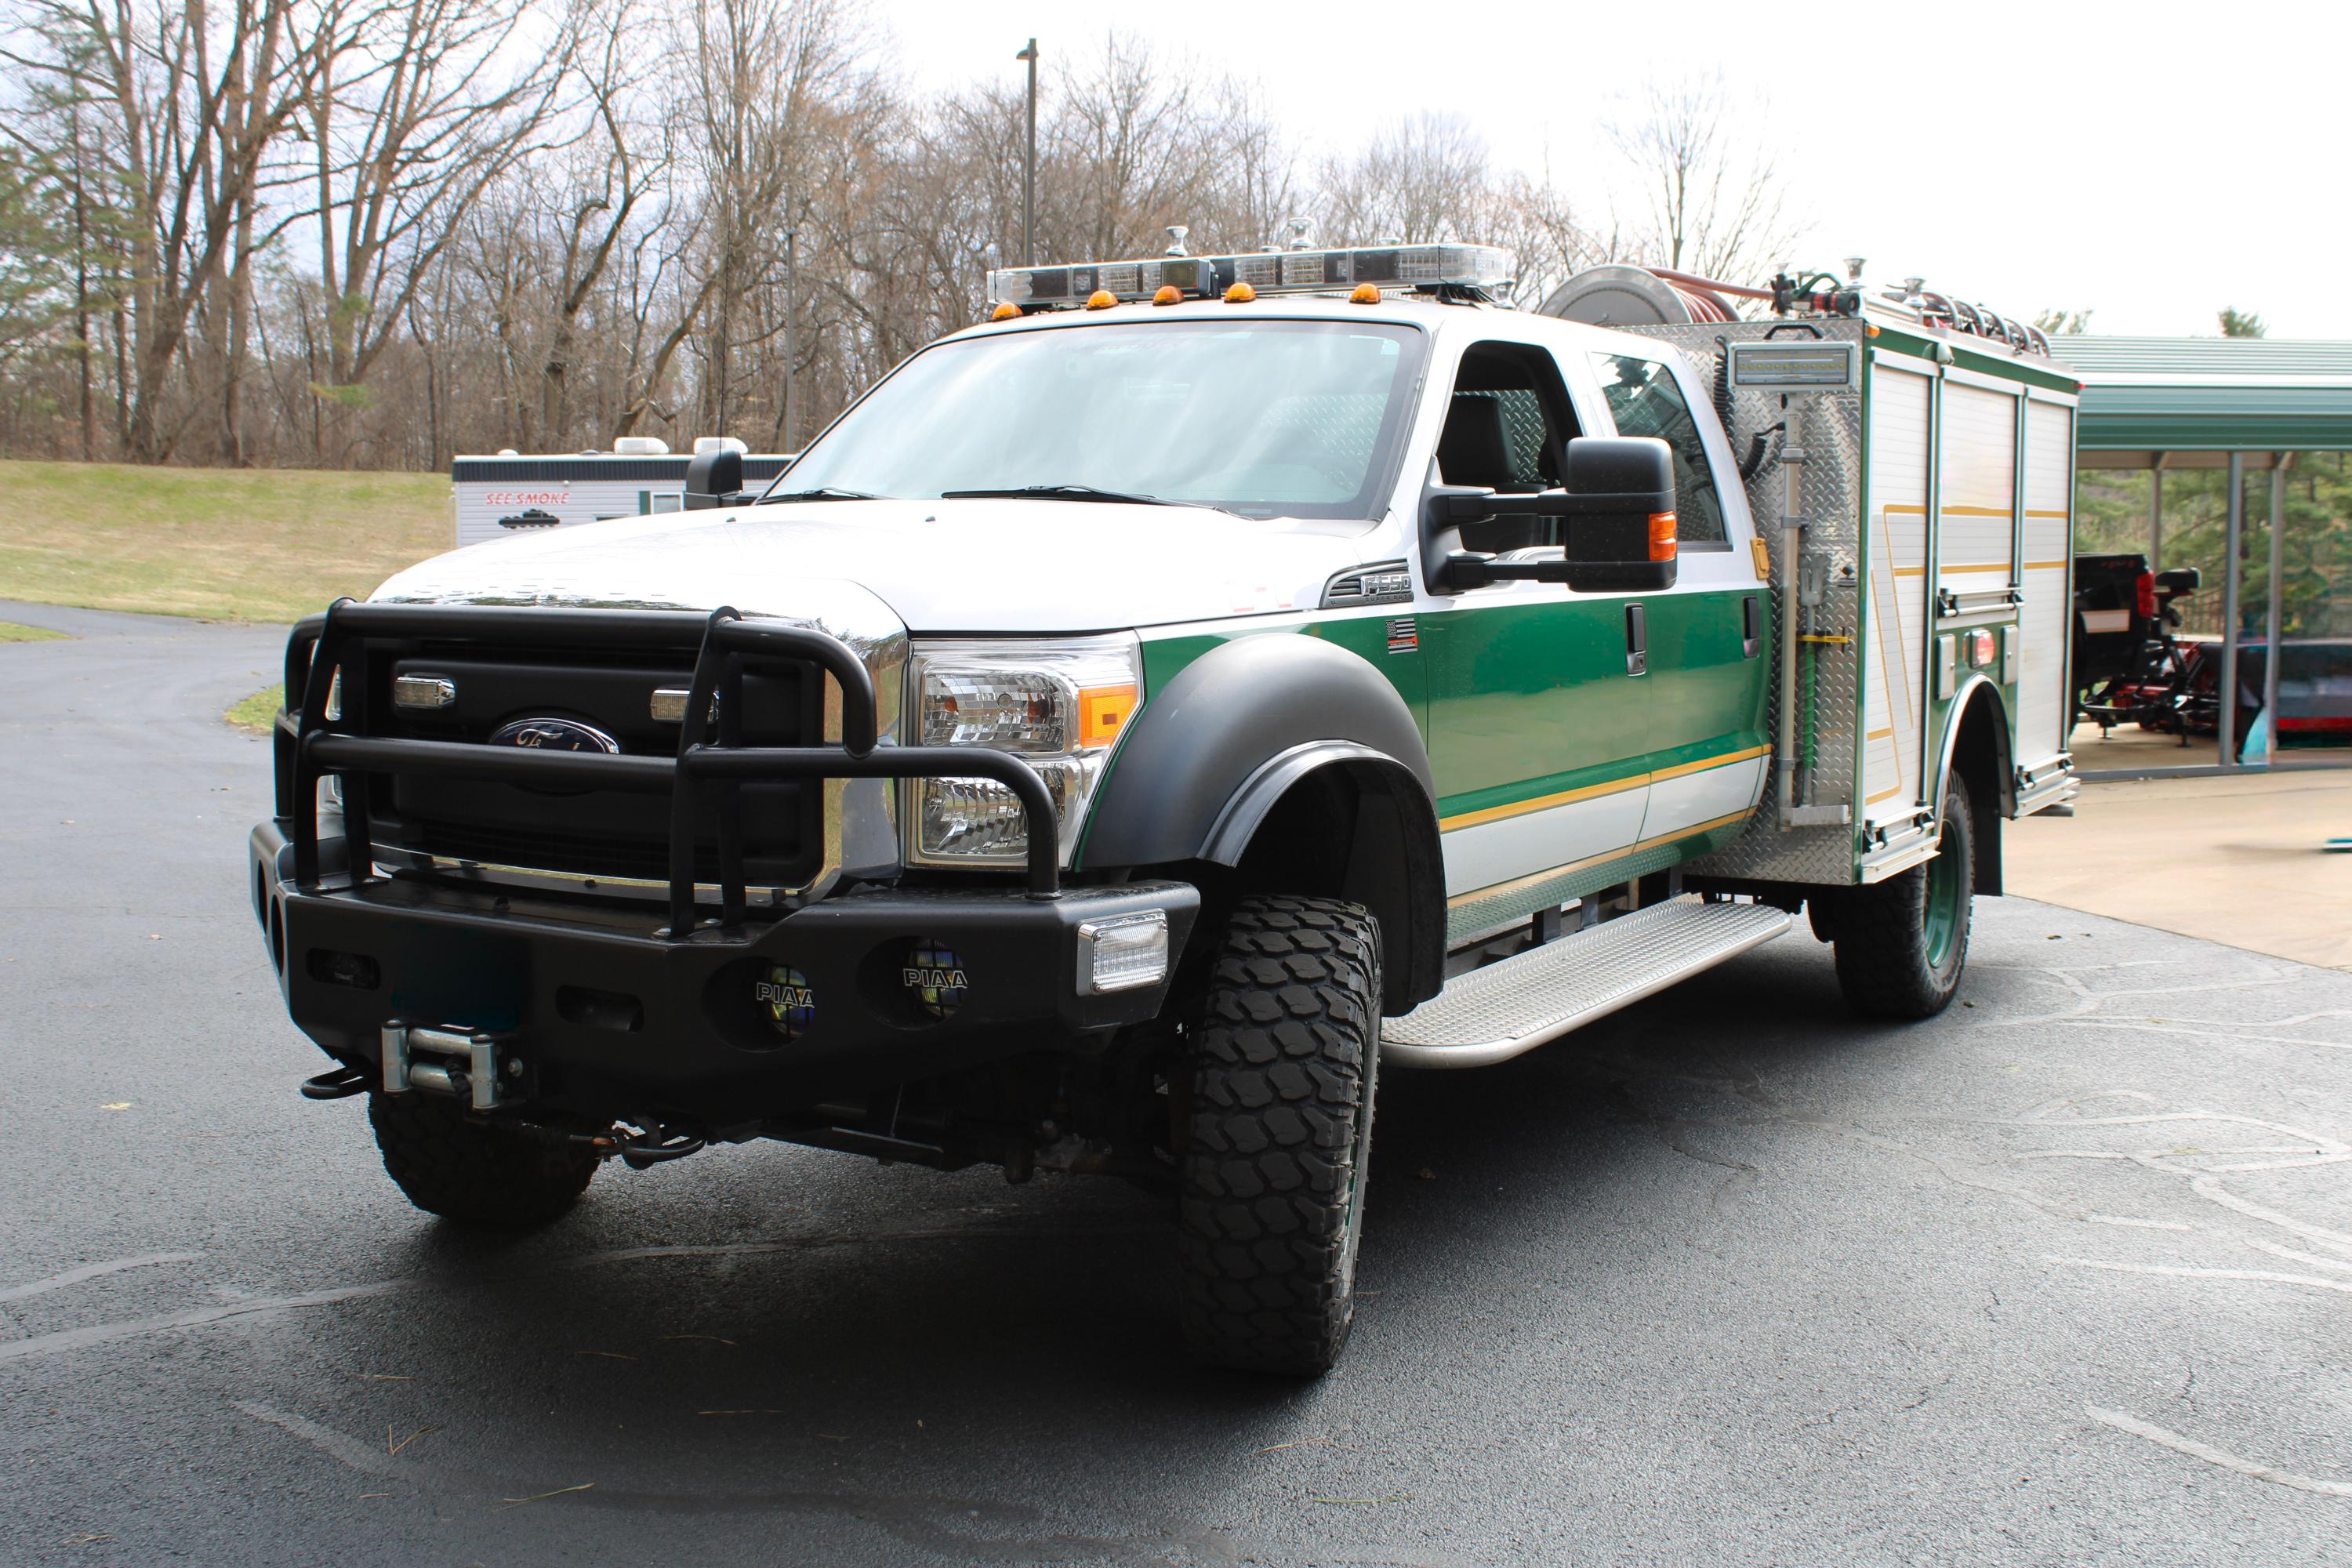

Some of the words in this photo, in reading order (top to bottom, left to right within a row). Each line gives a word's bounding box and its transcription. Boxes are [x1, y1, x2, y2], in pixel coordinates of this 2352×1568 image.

[486, 492, 513, 504] SEE
[516, 492, 571, 504] SMOKE
[903, 968, 967, 989] PIAA
[757, 982, 815, 1008] PIAA
